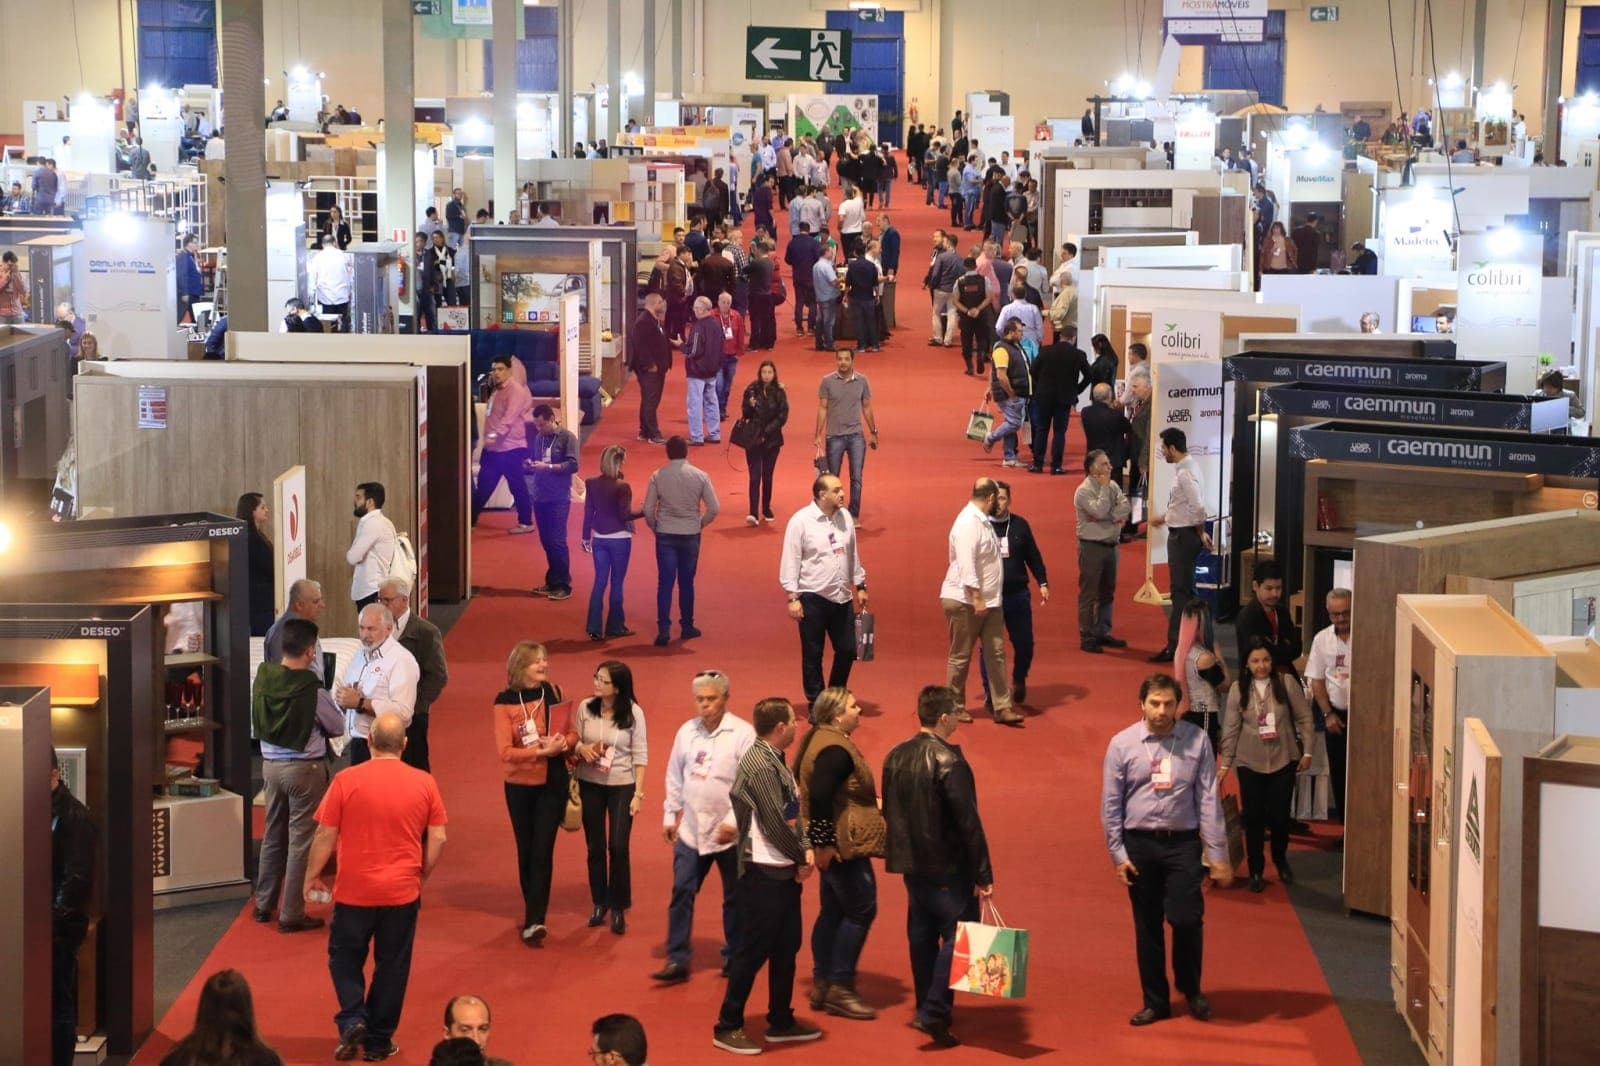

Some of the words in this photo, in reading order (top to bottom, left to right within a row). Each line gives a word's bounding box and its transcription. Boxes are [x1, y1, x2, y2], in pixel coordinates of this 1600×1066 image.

[1467, 269, 1522, 286] colibri
[1161, 331, 1201, 349] colibri
[1304, 363, 1391, 380] caemmun
[1168, 386, 1223, 398] caemmun
[1344, 396, 1436, 415] caemmun
[1200, 408, 1222, 417] aroma
[1450, 408, 1474, 417] aroma
[1387, 439, 1492, 460] caemmun
[1508, 452, 1536, 462] aroma
[208, 526, 240, 537] DESEO
[80, 627, 121, 636] DESEO
